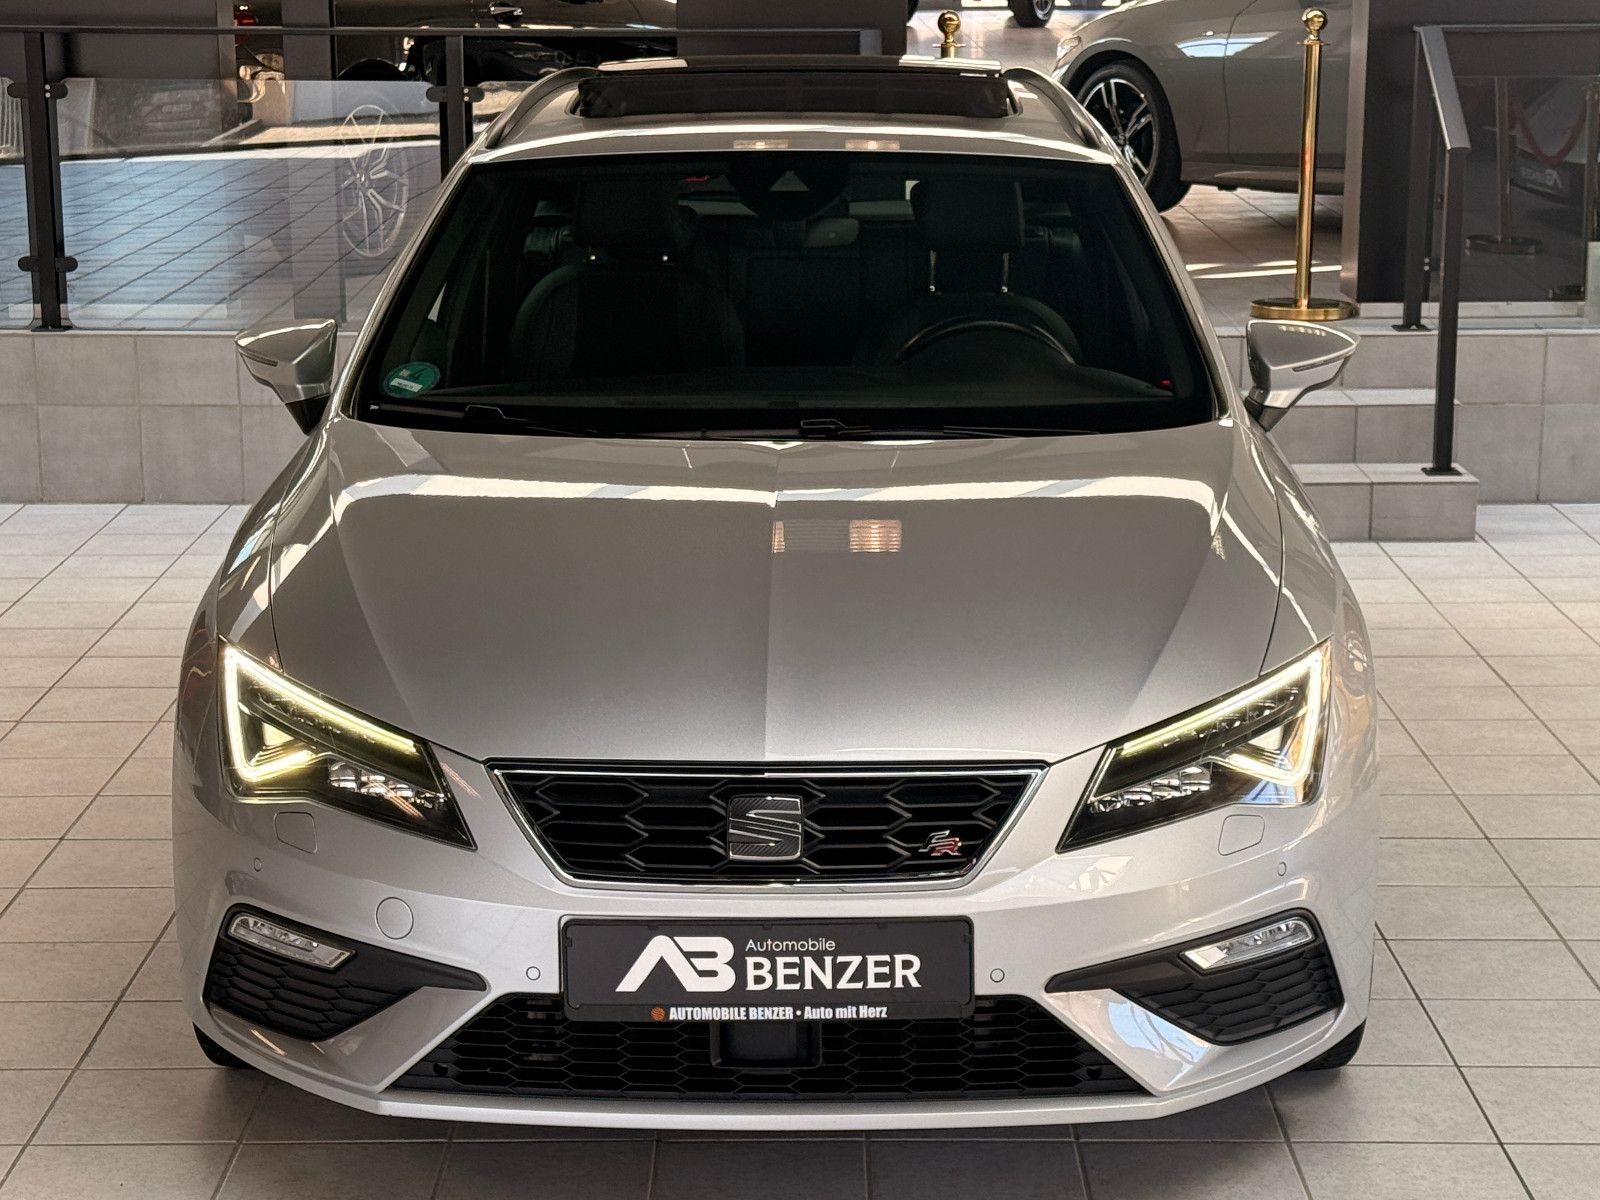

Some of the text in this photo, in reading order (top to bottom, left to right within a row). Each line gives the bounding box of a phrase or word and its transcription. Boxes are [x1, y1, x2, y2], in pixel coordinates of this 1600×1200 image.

[745, 937, 836, 952] Automobile
[615, 934, 736, 992] AB
[744, 953, 922, 991] BENZER
[668, 1004, 888, 1021] AUTOMOBILE BENZER Auto mit Herz
